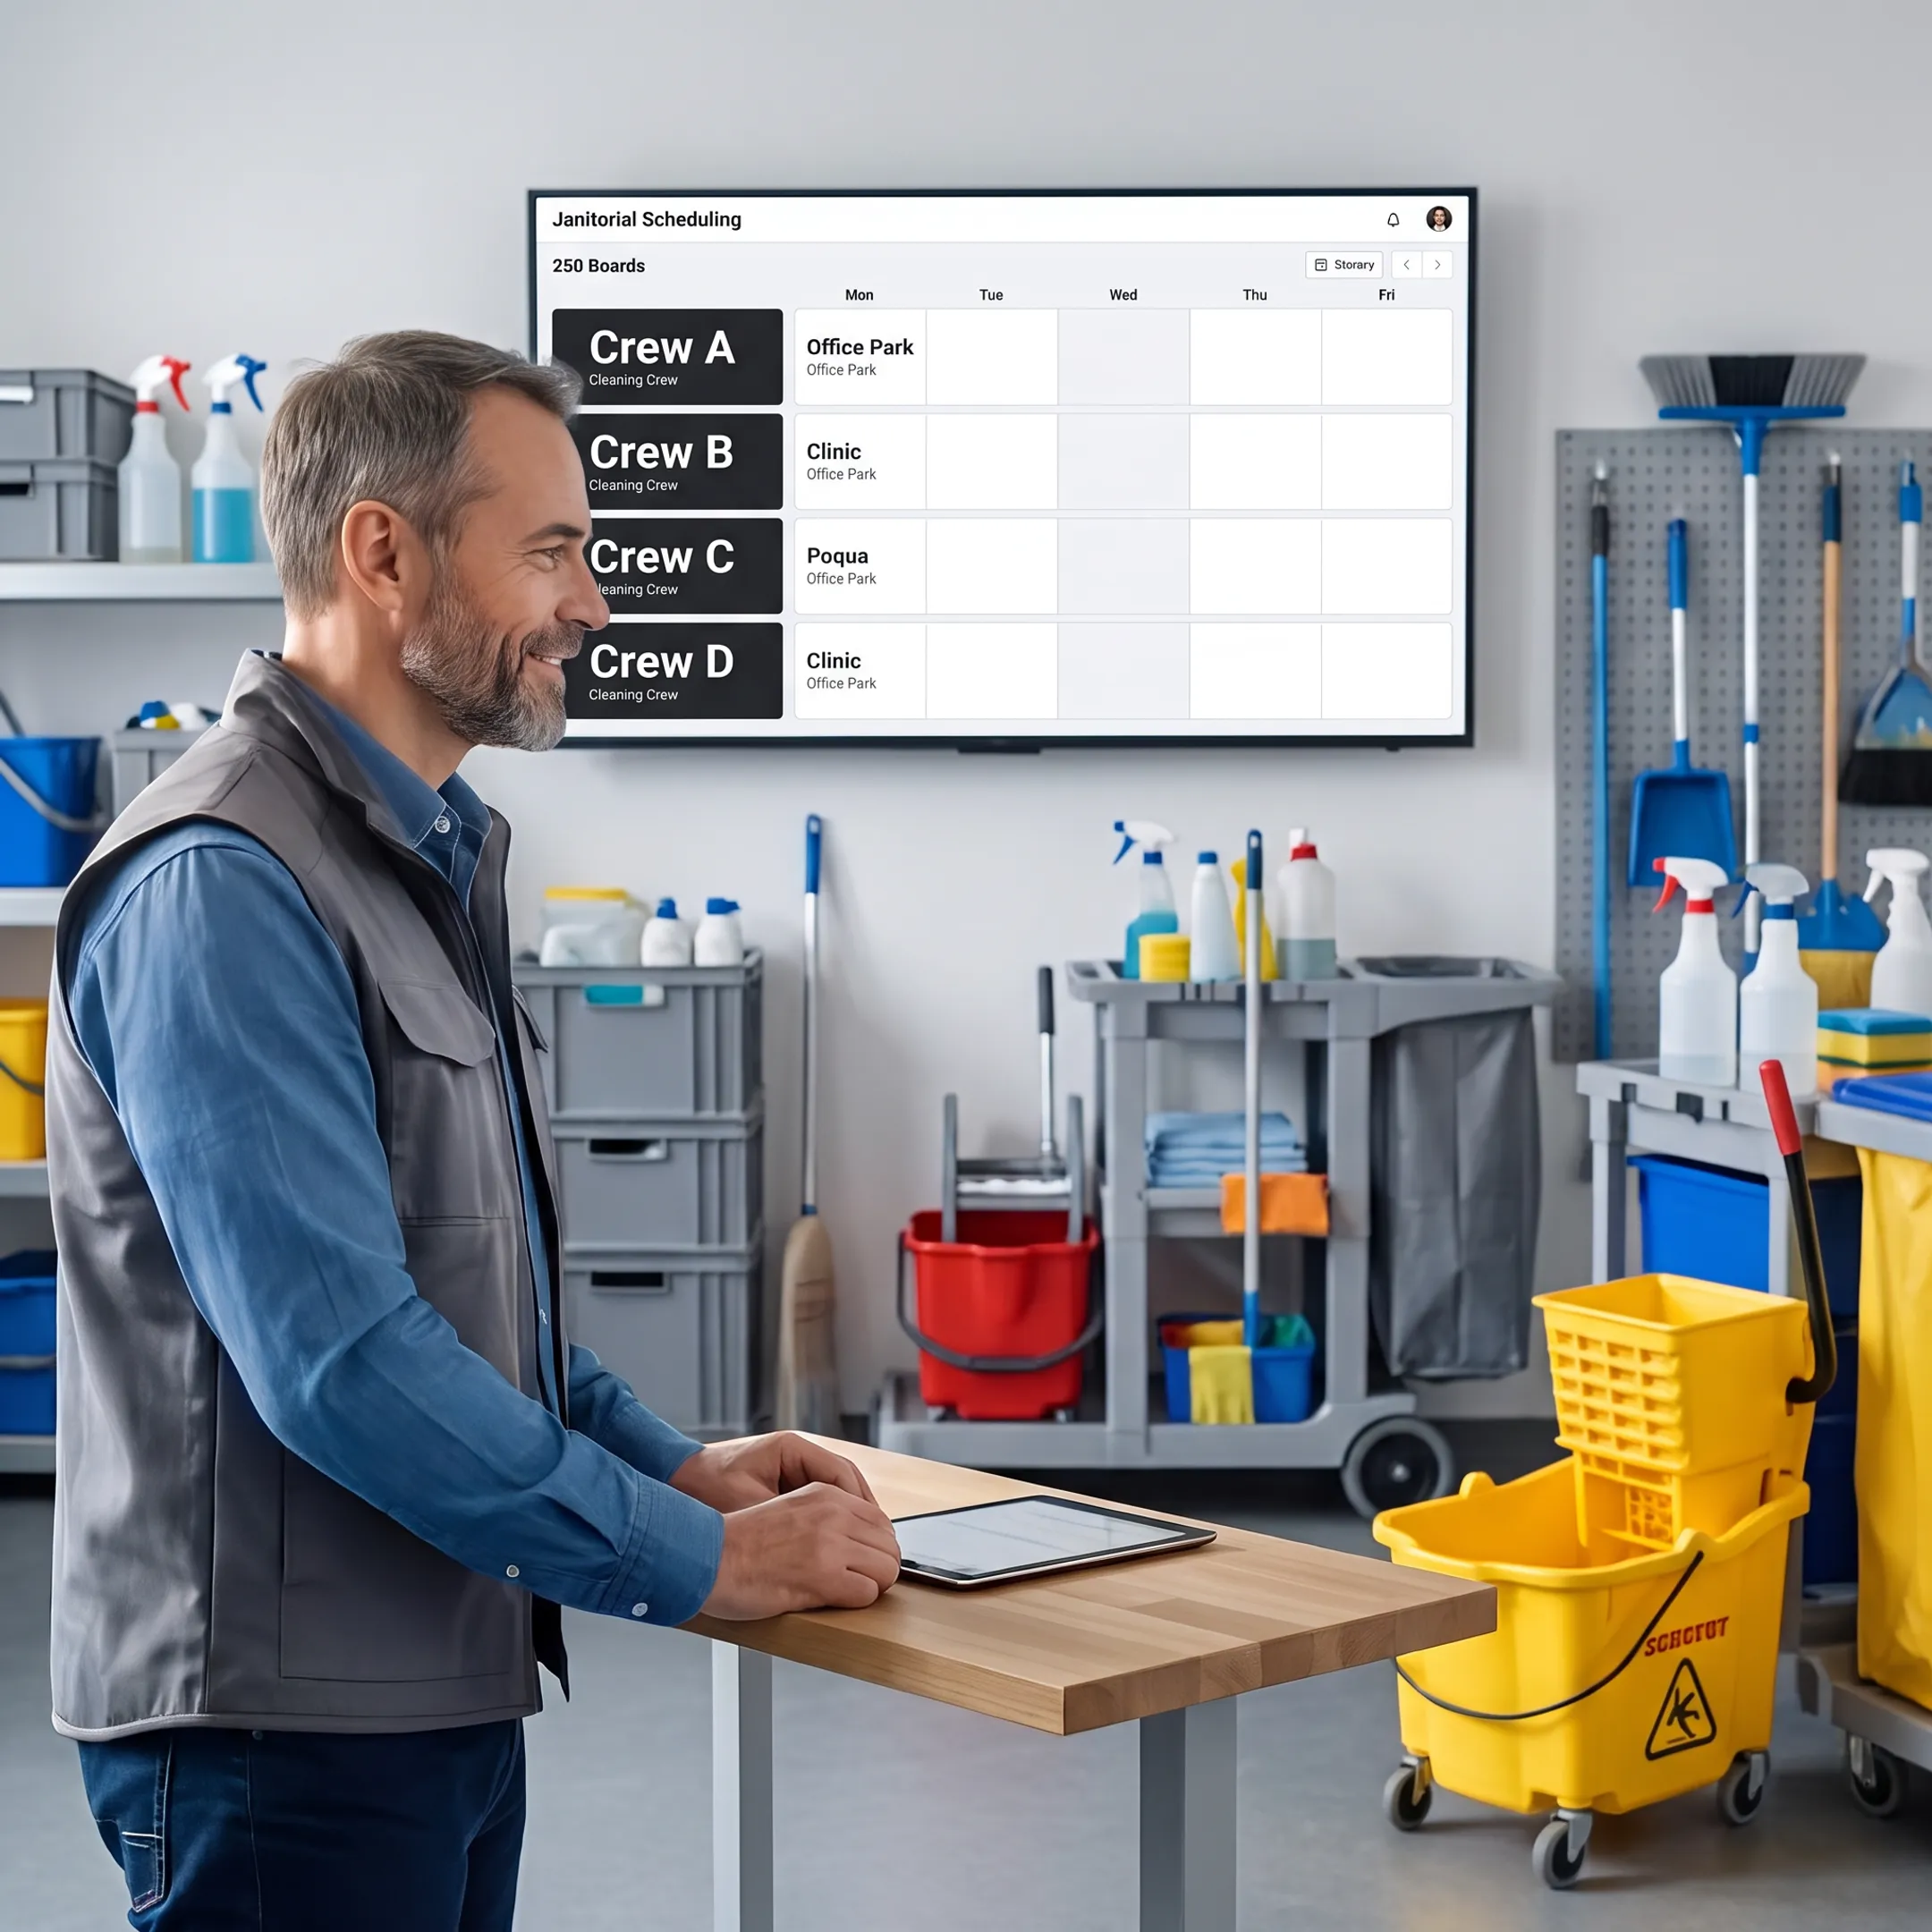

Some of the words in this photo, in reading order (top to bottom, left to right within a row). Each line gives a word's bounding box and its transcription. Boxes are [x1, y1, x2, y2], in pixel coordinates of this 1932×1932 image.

[553, 211, 636, 227] Janitorial
[642, 211, 741, 231] Scheduling
[553, 258, 583, 273] 250
[589, 258, 645, 273] Boards
[1335, 259, 1375, 271] Storary
[846, 289, 873, 301] Mon
[979, 289, 1004, 301] Tue
[1110, 289, 1137, 301] Wed
[1242, 289, 1267, 301] Thu
[1379, 289, 1394, 301] Fri
[590, 330, 693, 364] Crew
[705, 330, 735, 364] A
[808, 338, 864, 355] Office
[870, 338, 914, 355] Park
[807, 363, 843, 376] Office
[848, 363, 877, 376] Park
[589, 374, 642, 388] Cleaning
[647, 374, 678, 386] Crew
[591, 435, 693, 469] Crew
[708, 435, 733, 469] B
[807, 442, 861, 460] Clinic
[807, 468, 843, 479] Office
[848, 468, 877, 479] Park
[589, 479, 642, 493] Cleaning
[647, 479, 678, 490] Crew
[591, 539, 693, 573] Crew
[707, 539, 733, 573] C
[808, 547, 868, 568] Poqua
[807, 572, 843, 584] Office
[848, 572, 877, 584] Park
[598, 583, 643, 597] leaning
[647, 583, 678, 595] Crew
[591, 644, 693, 678] Crew
[708, 644, 733, 678] D
[807, 651, 861, 669] Clinic
[807, 677, 843, 689] Office
[848, 677, 877, 689] Park
[589, 689, 642, 703] Cleaning
[647, 689, 678, 699] Crew
